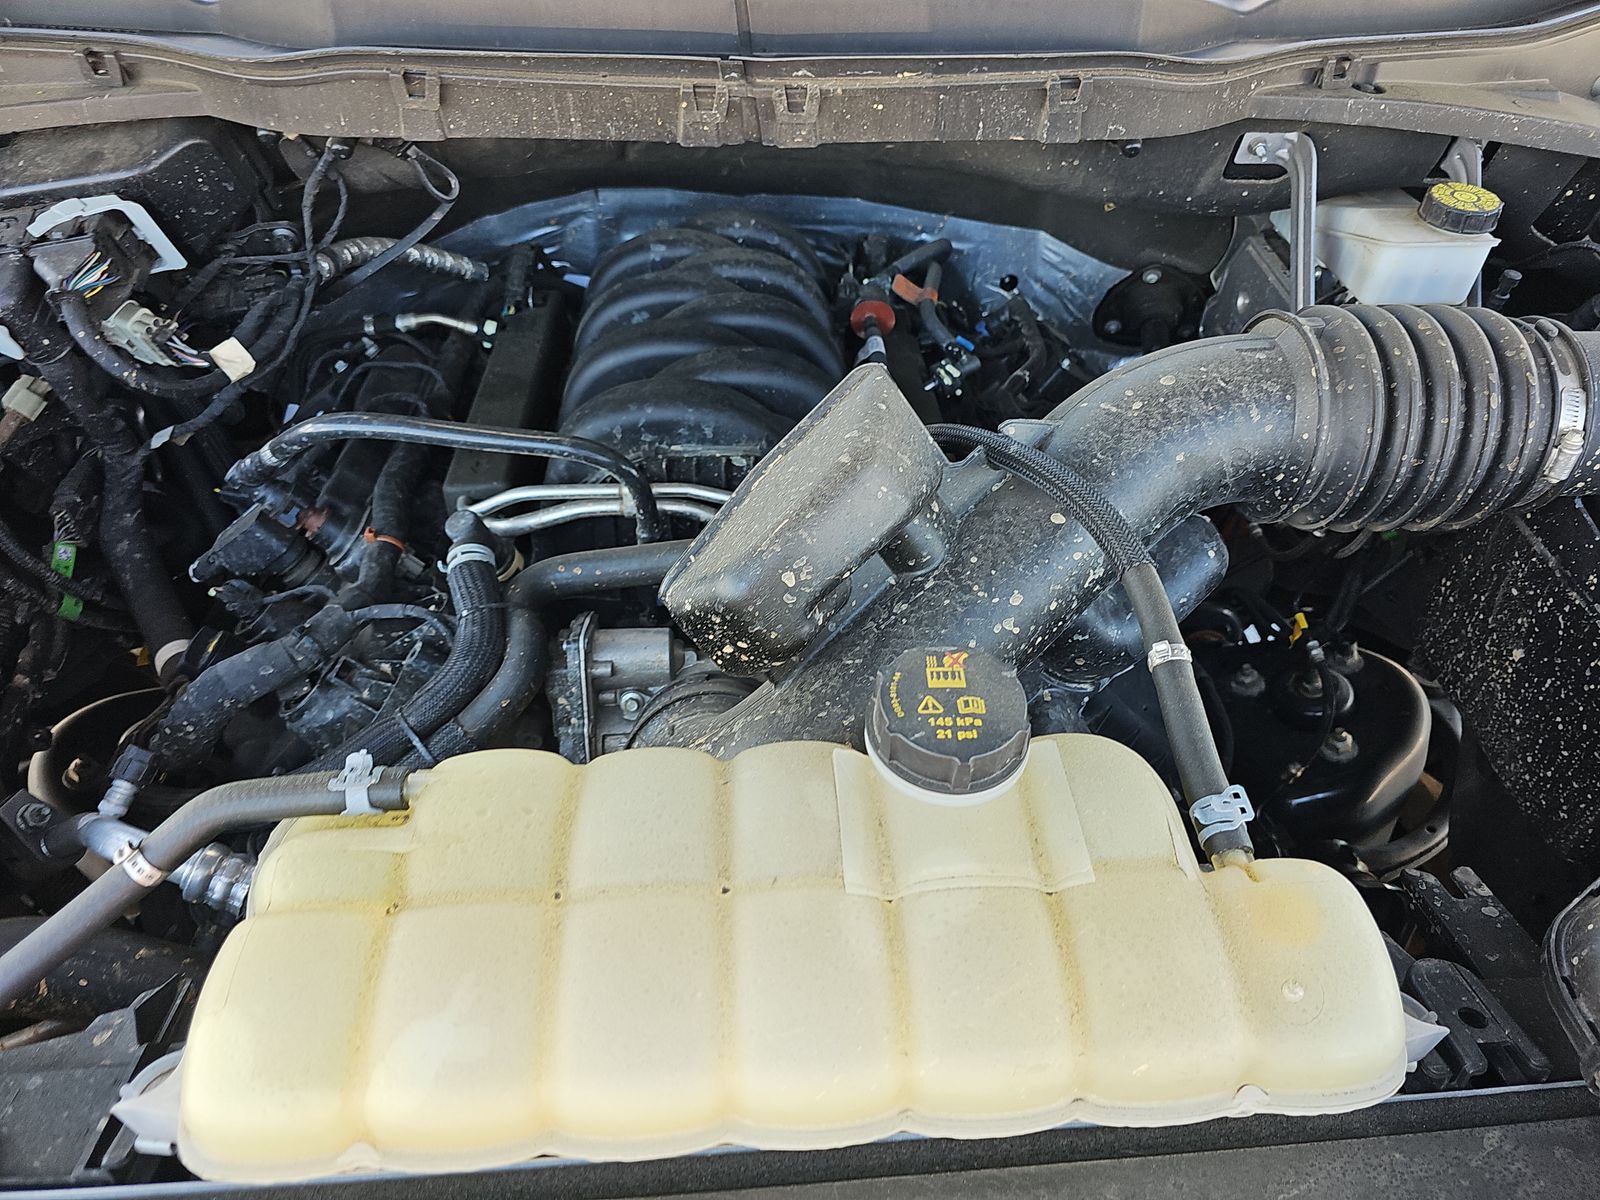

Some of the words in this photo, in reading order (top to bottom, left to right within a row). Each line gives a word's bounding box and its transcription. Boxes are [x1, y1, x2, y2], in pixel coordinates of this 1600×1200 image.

[928, 716, 954, 727] 145
[956, 716, 983, 727] kPa
[936, 729, 953, 740] 21
[957, 729, 978, 741] psi
